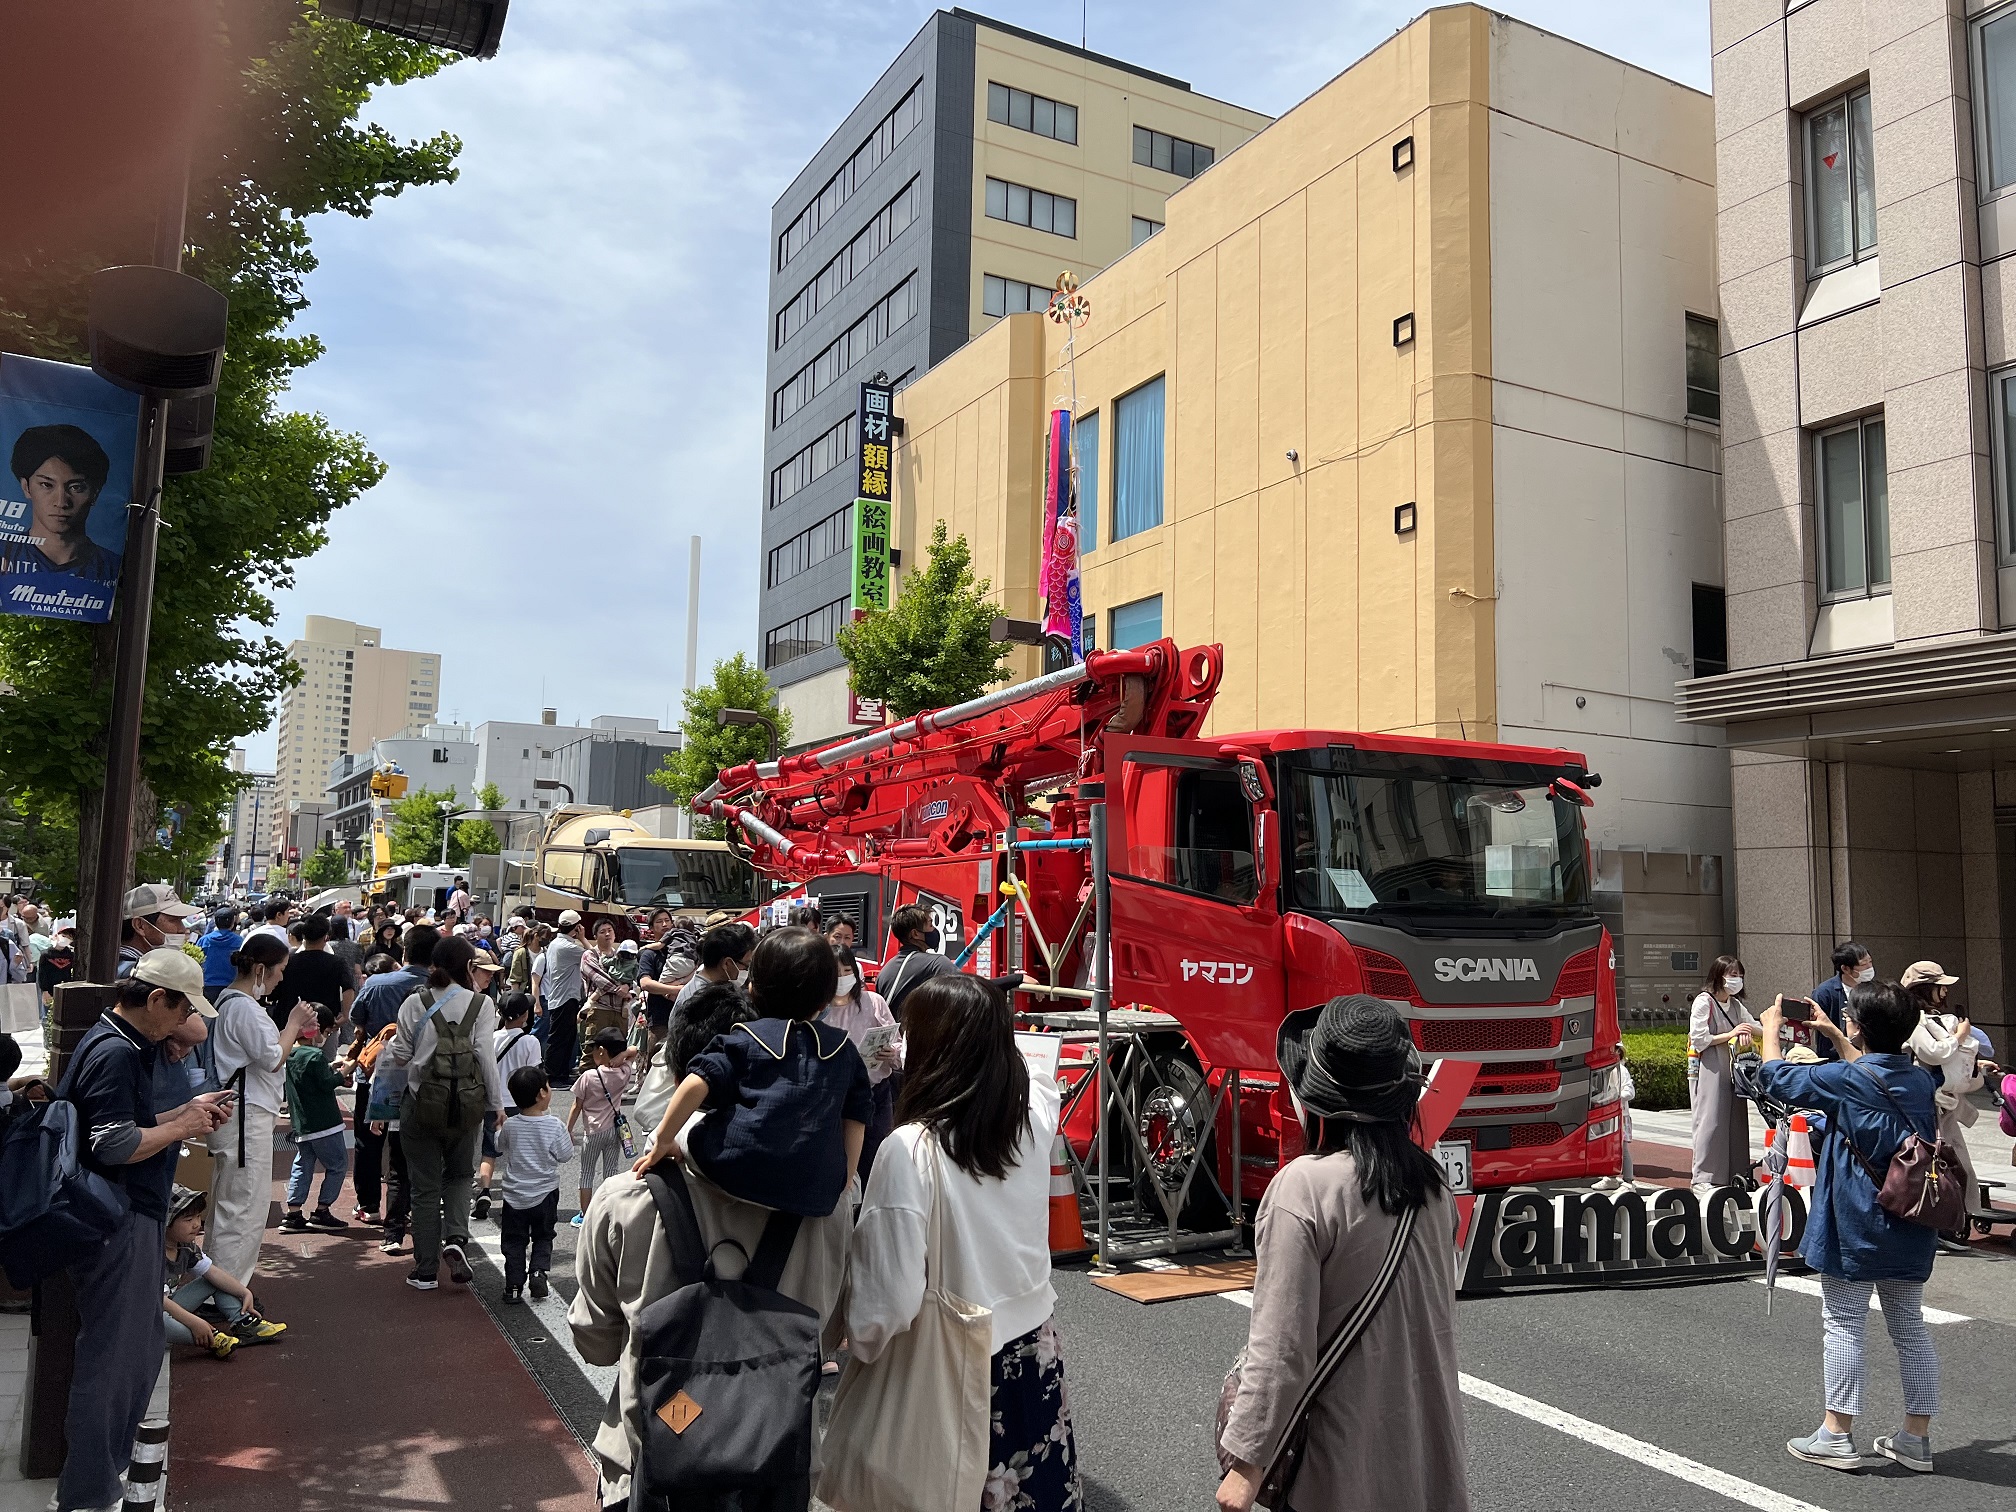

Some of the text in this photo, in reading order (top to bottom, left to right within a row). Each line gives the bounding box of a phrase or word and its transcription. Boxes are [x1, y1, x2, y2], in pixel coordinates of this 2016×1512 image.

[861, 388, 890, 496] 画材 額縁
[860, 504, 887, 607] 絵画教室
[9, 584, 105, 610] Montedio
[30, 604, 83, 616] YAMAGATA
[1180, 958, 1254, 985] ヤマコン
[1434, 957, 1541, 982] SCANIA
